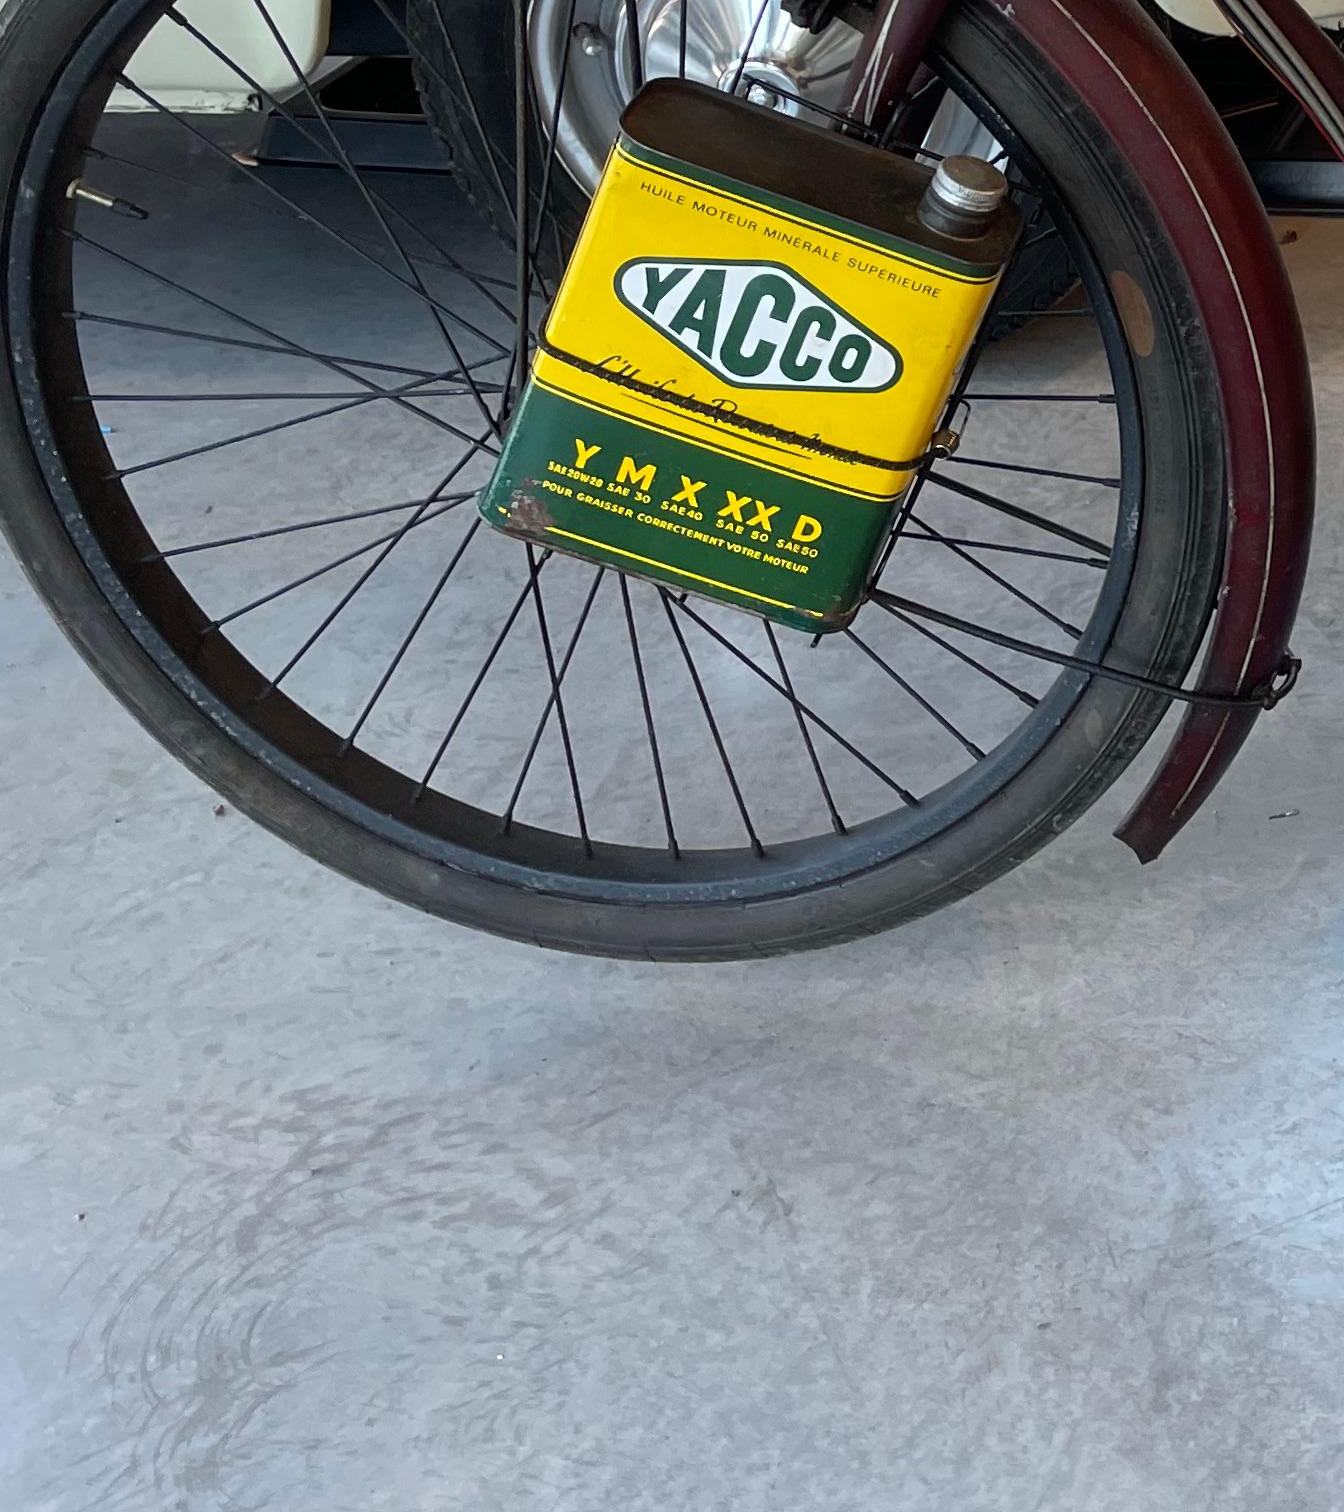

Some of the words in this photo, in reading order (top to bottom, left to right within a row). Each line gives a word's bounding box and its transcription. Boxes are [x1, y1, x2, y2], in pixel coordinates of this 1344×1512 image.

[640, 181, 685, 205] HUILE
[692, 200, 757, 232] MOTEUR
[642, 267, 871, 384] YACCO
[542, 480, 573, 498] POUR
[576, 492, 634, 518] GRAISSER
[636, 513, 725, 548] CORRECTEMENT
[726, 541, 762, 560] VOTRE
[762, 552, 809, 574] MOTEUR
[575, 439, 602, 468] Y
[615, 456, 657, 491] M
[671, 474, 708, 508] X
[717, 490, 781, 532] XX
[791, 514, 823, 543] D
[634, 491, 651, 504] 30
[715, 519, 745, 535] SAE
